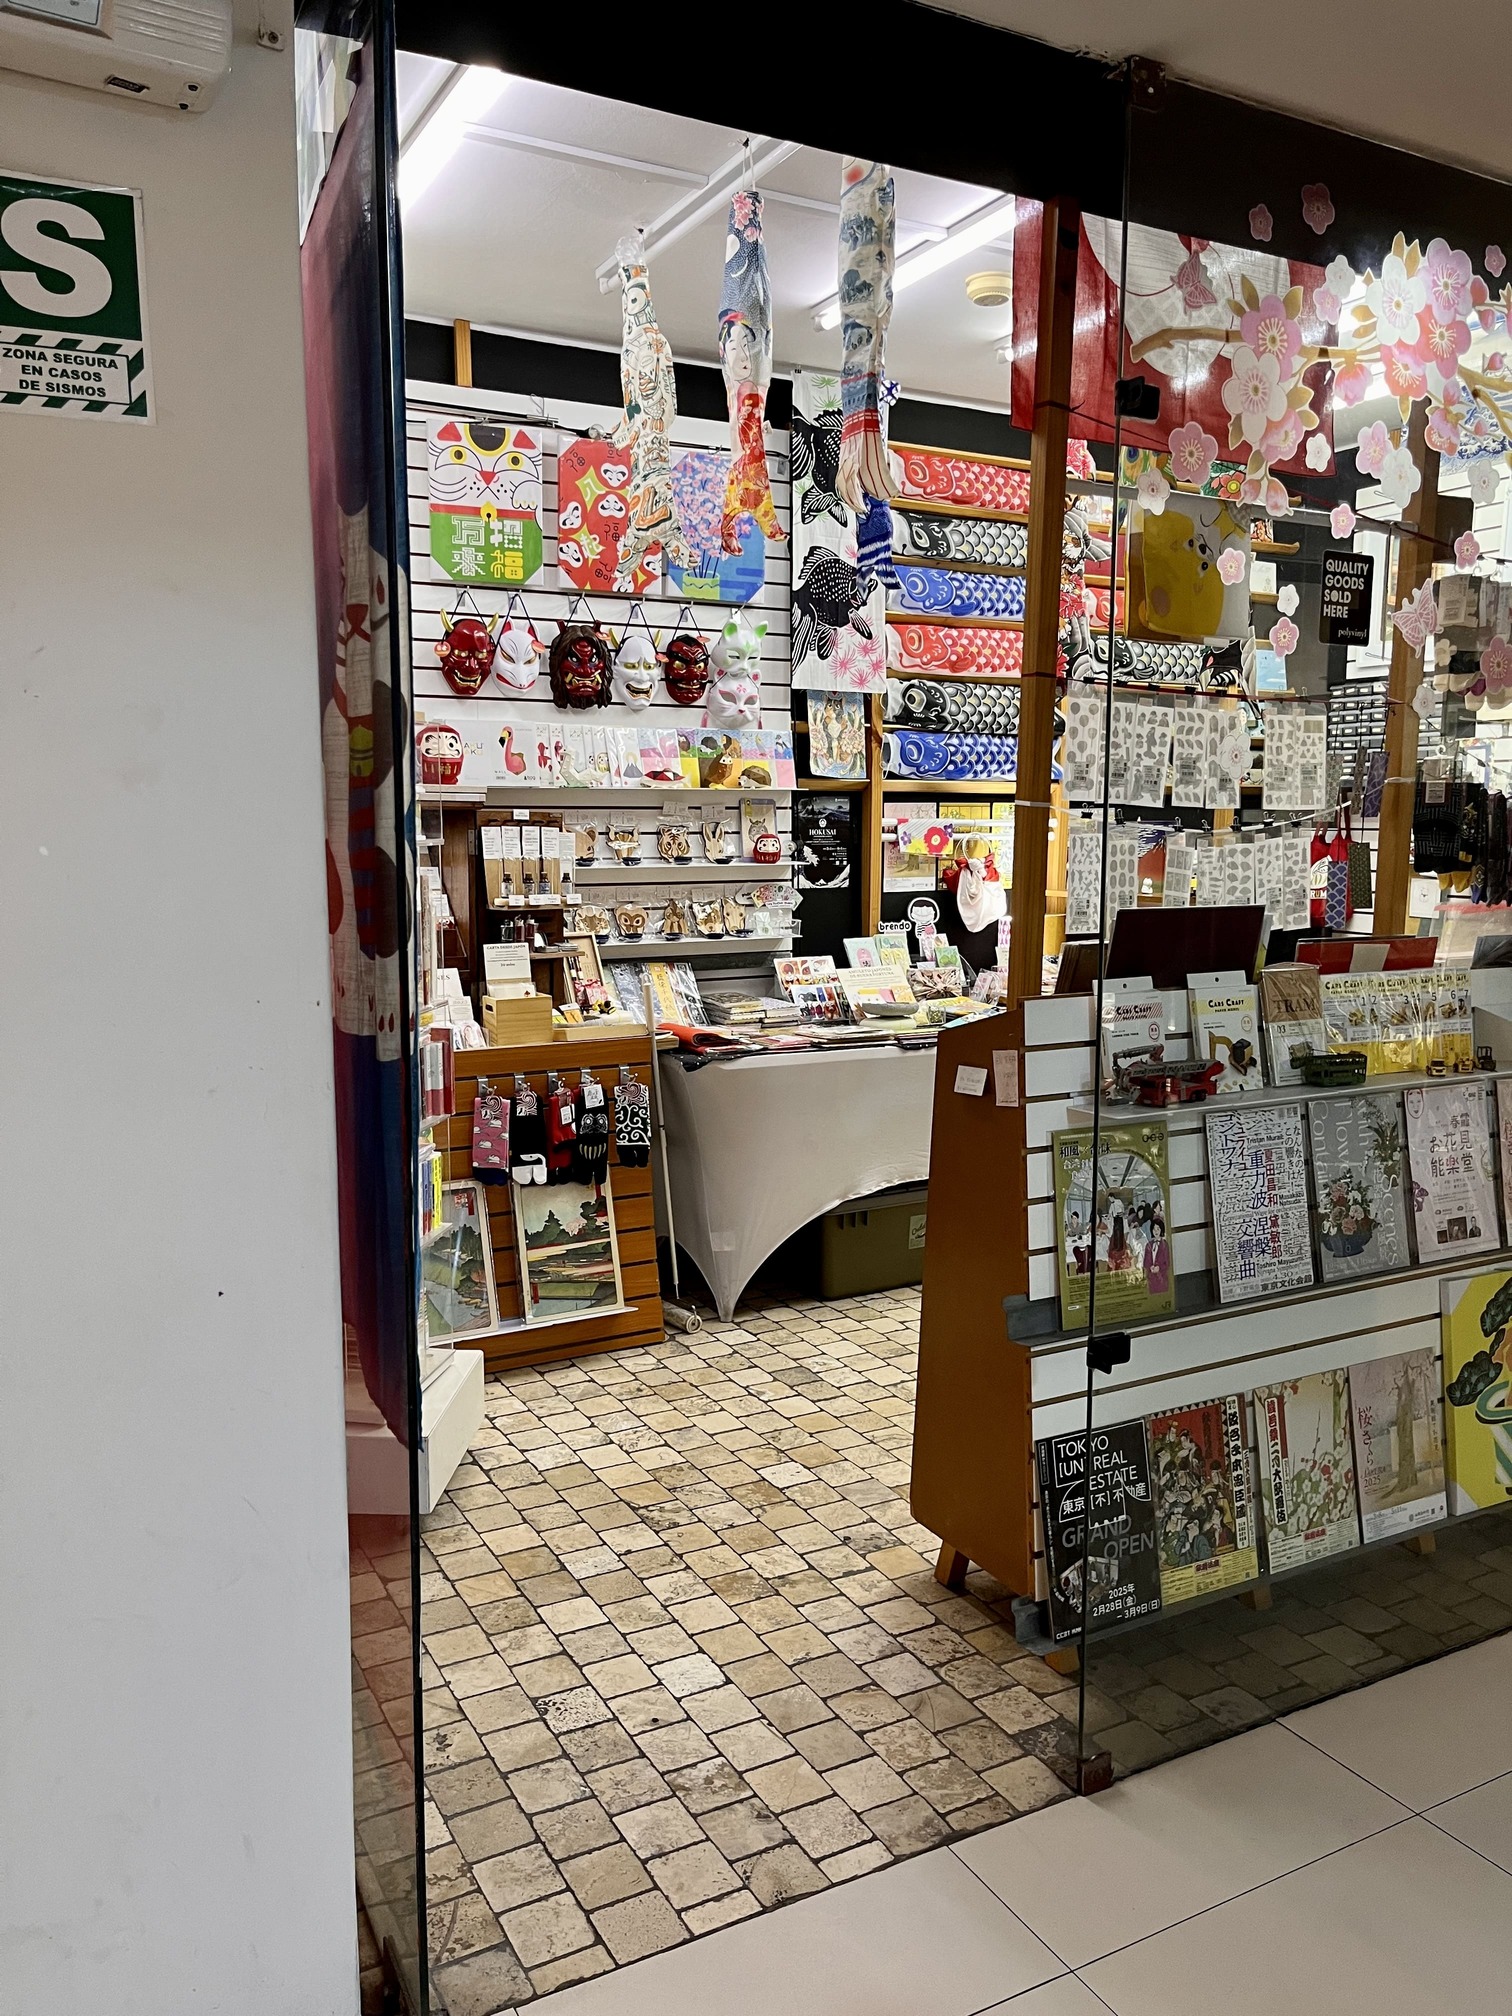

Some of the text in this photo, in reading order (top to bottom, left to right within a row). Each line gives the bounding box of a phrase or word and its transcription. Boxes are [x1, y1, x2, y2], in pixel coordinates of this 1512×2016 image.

[0, 197, 113, 318] S
[2, 347, 119, 370] ZONA SEGURA
[21, 364, 103, 383] EN CASOS
[19, 379, 107, 398] DE SISMOS
[1325, 559, 1369, 576] QUALITY
[1324, 574, 1365, 590] GOODS
[1323, 589, 1352, 604] SOLD
[1323, 604, 1349, 619] HERE
[1338, 627, 1367, 640] polyvinyl
[809, 828, 837, 836] HOKUSAI
[879, 921, 911, 932] brendo
[1325, 981, 1342, 990] CARS
[1450, 989, 1456, 1000] 6
[1463, 989, 1469, 999] 7
[1208, 998, 1244, 1008] CARS CRAFT
[1404, 995, 1410, 1005] 3
[1431, 992, 1437, 1002] 5
[1273, 999, 1316, 1014] TRAM
[1333, 1101, 1353, 1192] Flower
[1429, 1130, 1473, 1153] お花見
[1430, 1152, 1475, 1178] 能楽堂
[1248, 1149, 1269, 1210] 重力波
[1263, 1149, 1279, 1207] 夏田昌和
[1380, 1173, 1399, 1266] Scenes
[1252, 1215, 1271, 1258] 涅槃
[1236, 1218, 1257, 1280] 交響曲
[1256, 1260, 1277, 1269] Toshiro
[1261, 1274, 1312, 1292] 東京文化会館
[1358, 1405, 1374, 1466] 桜さくら
[1057, 1435, 1109, 1459] TOKYO
[1089, 1465, 1138, 1491] ESTATE
[1364, 1476, 1381, 1488] 2025
[1103, 1531, 1155, 1560] OPEN
[1108, 1583, 1136, 1600] 2025年
[1092, 1594, 1137, 1617] 2月28日(金)
